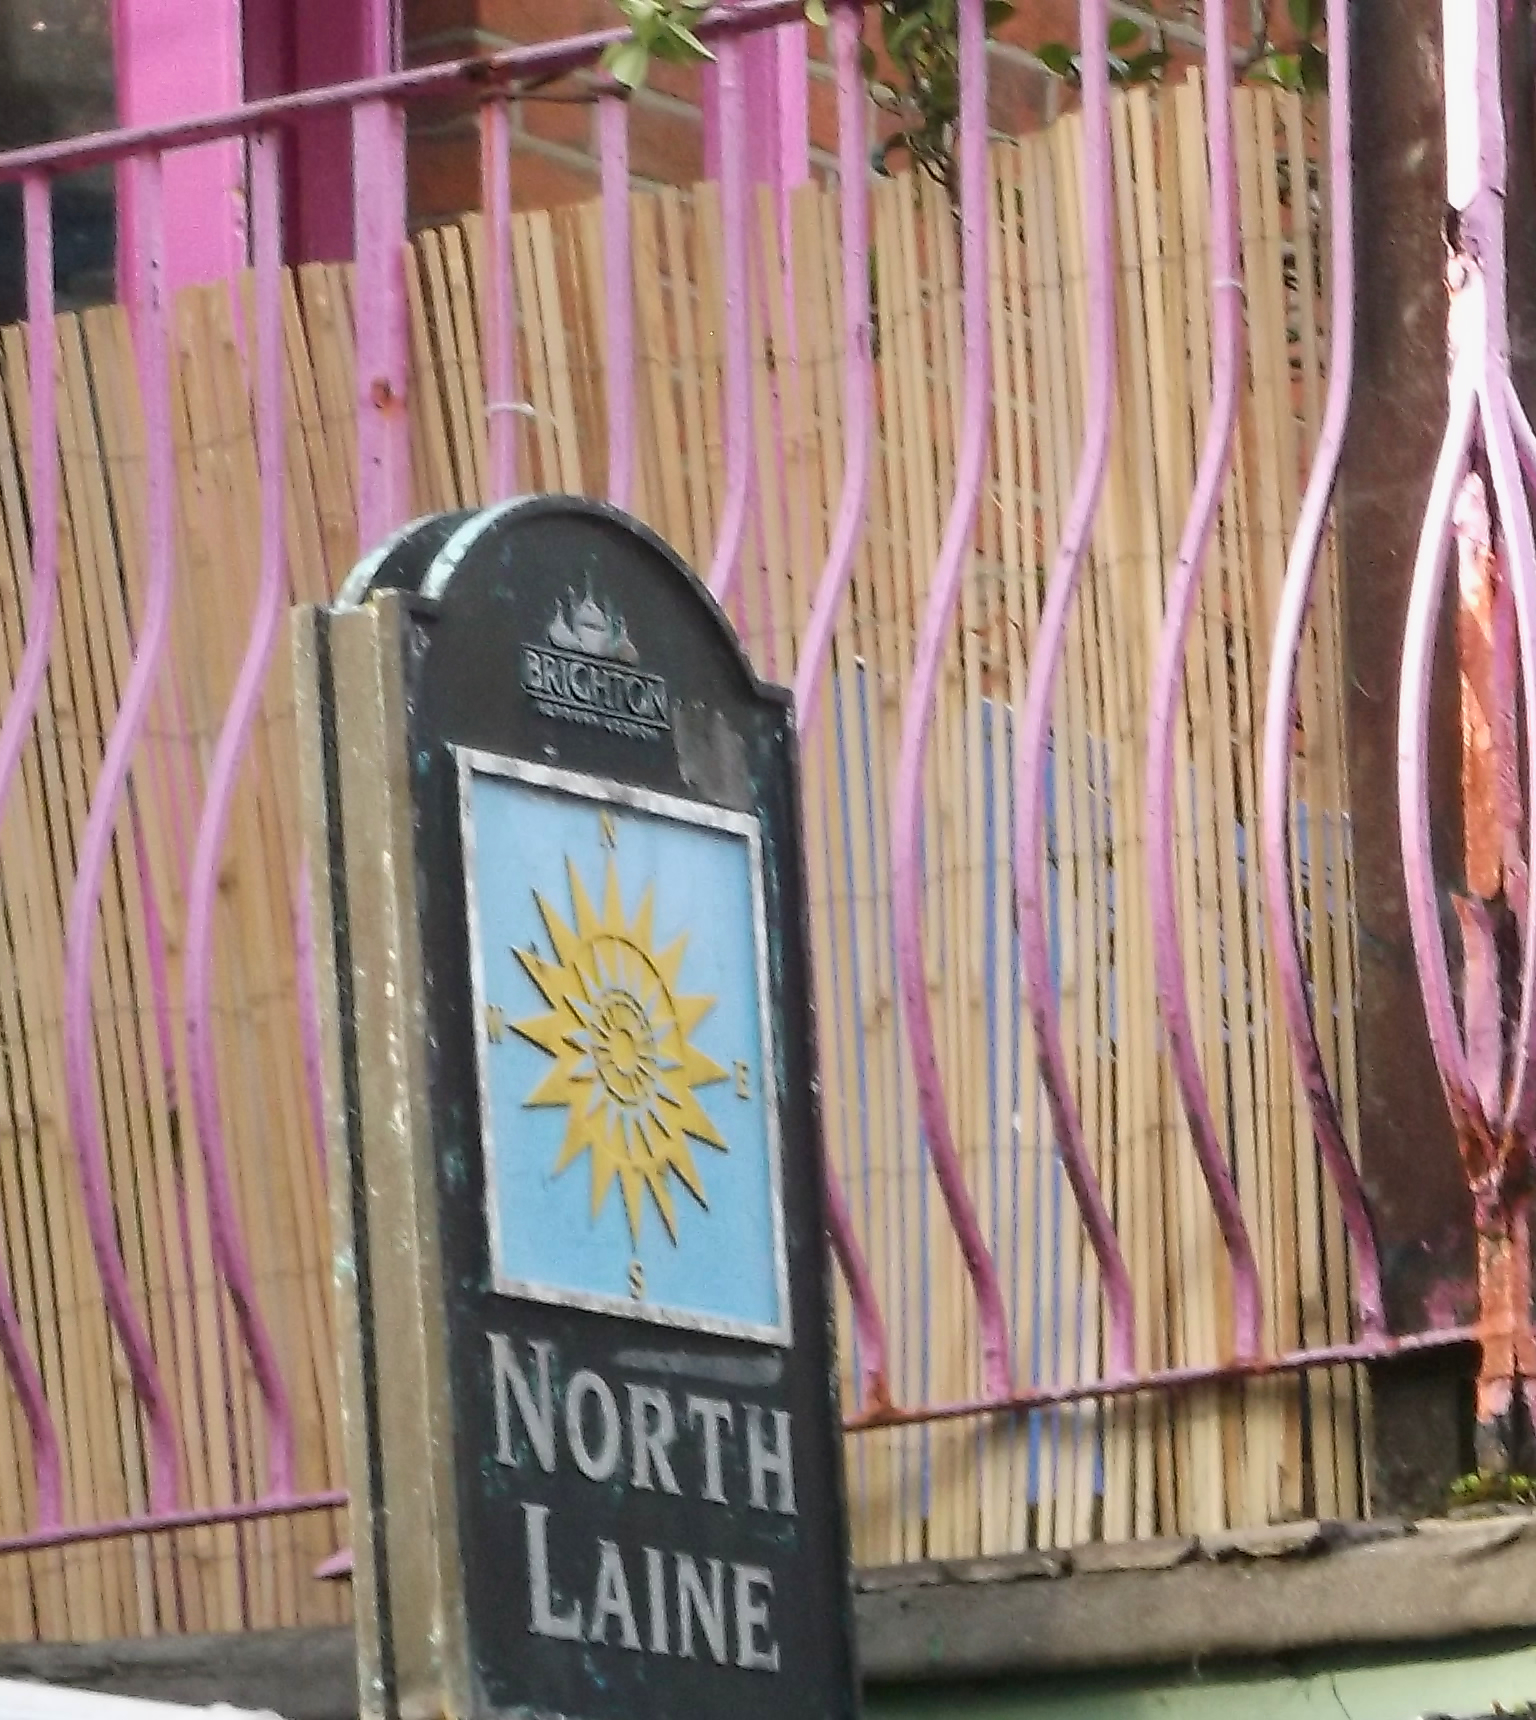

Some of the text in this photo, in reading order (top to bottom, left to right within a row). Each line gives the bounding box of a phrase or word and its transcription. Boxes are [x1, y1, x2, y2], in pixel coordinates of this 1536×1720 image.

[522, 649, 668, 721] BRIGHTON
[599, 807, 618, 850] N
[733, 1059, 751, 1100] E
[627, 1258, 646, 1300] S
